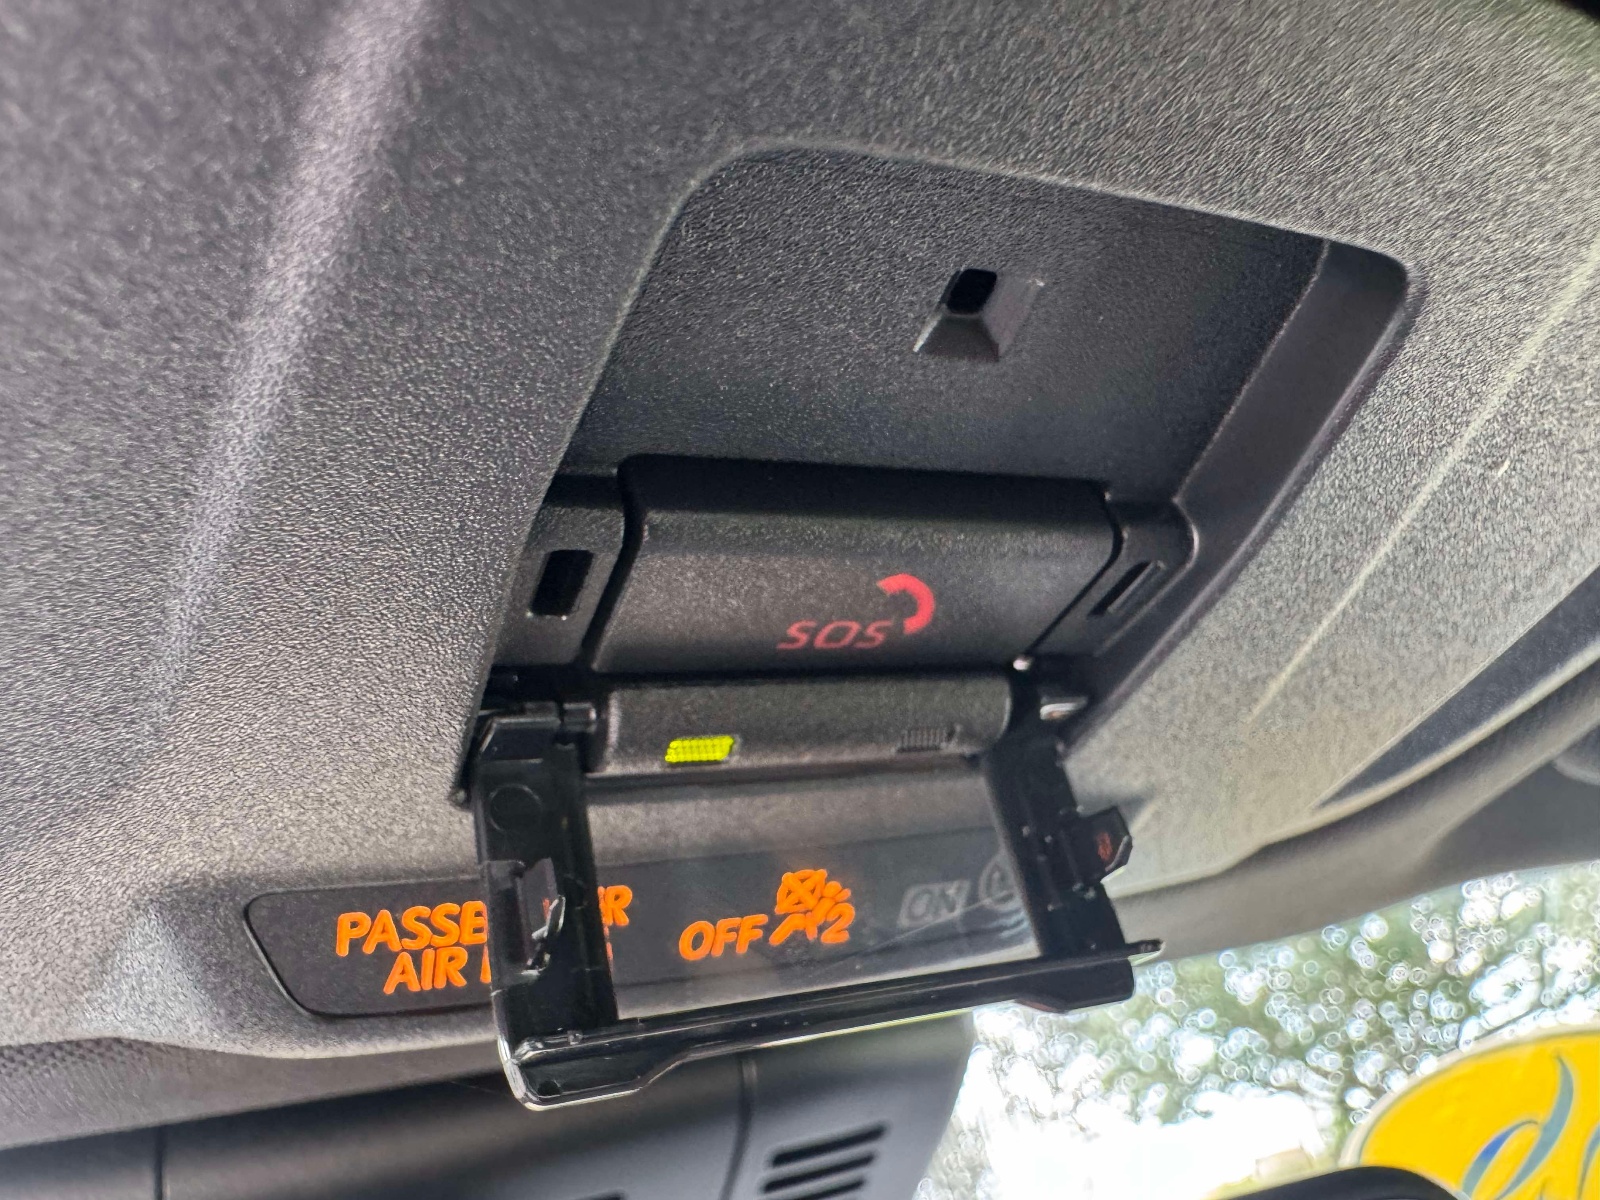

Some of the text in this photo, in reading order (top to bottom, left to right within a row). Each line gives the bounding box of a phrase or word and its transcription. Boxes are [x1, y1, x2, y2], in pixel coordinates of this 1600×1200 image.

[777, 619, 891, 650] SOS
[335, 884, 633, 957] PASSER
[679, 913, 769, 961] OFF
[383, 946, 468, 995] AIR
